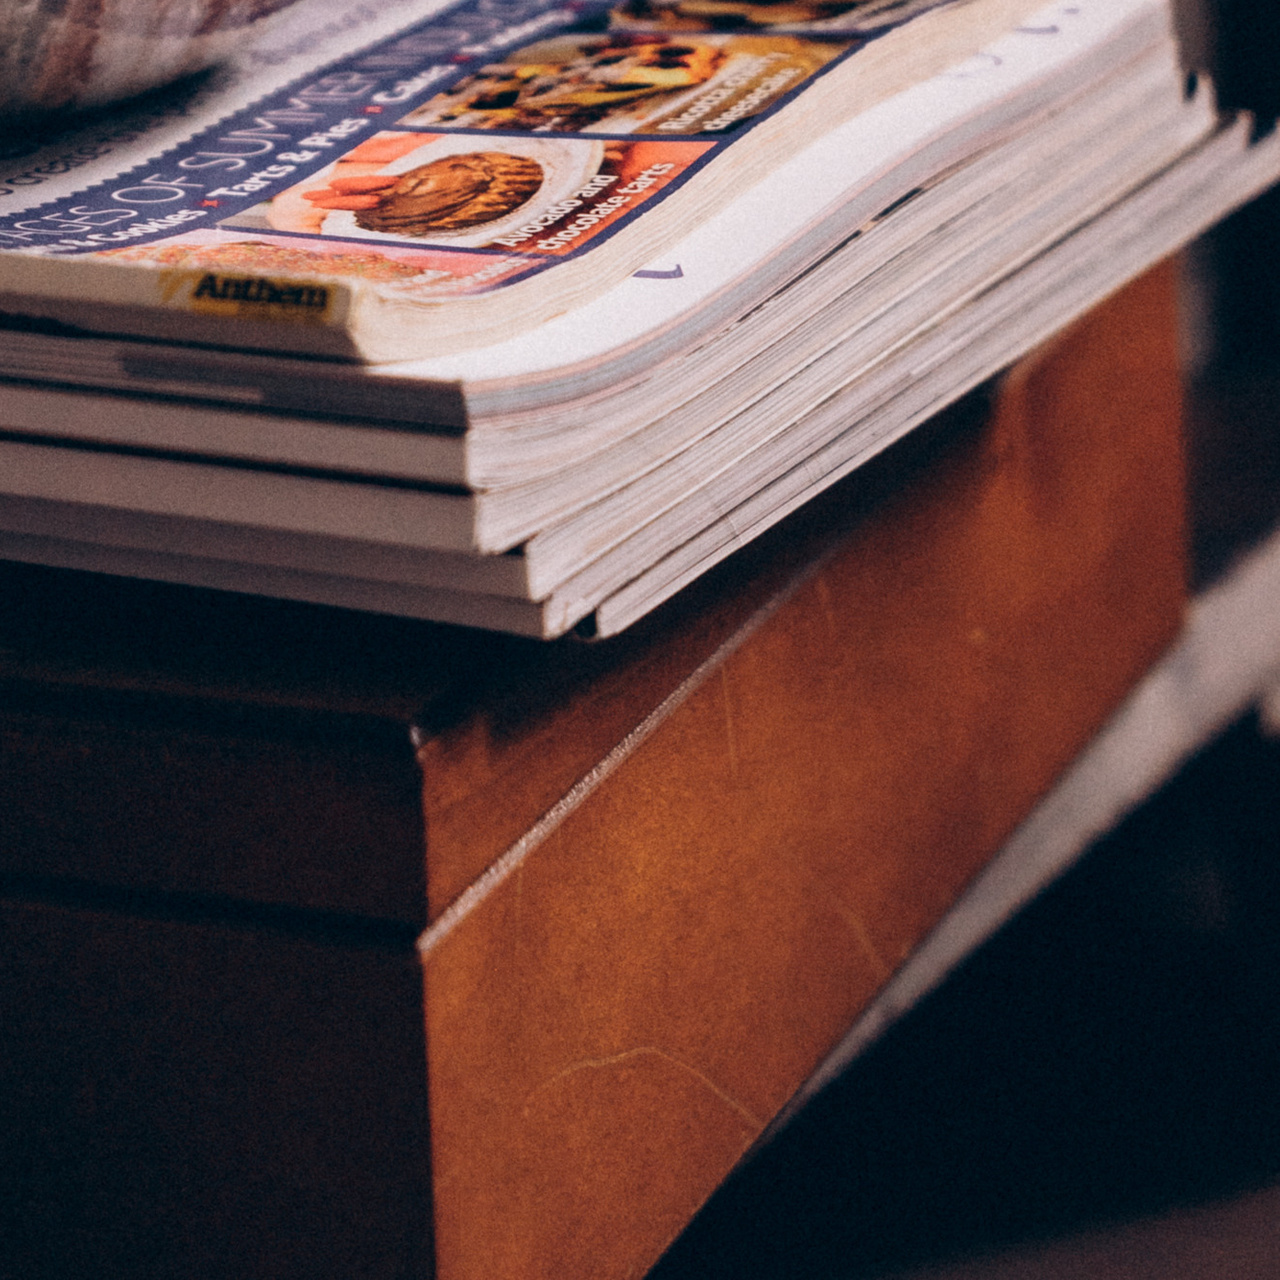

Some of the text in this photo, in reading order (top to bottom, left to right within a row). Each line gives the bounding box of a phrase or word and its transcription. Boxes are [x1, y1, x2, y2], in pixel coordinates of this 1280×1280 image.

[297, 117, 370, 147] Pies
[276, 150, 322, 164] &
[111, 173, 206, 205] OF
[206, 164, 297, 198] Tarts
[494, 174, 620, 248] Avocado and
[537, 162, 676, 250] chocolate tarts
